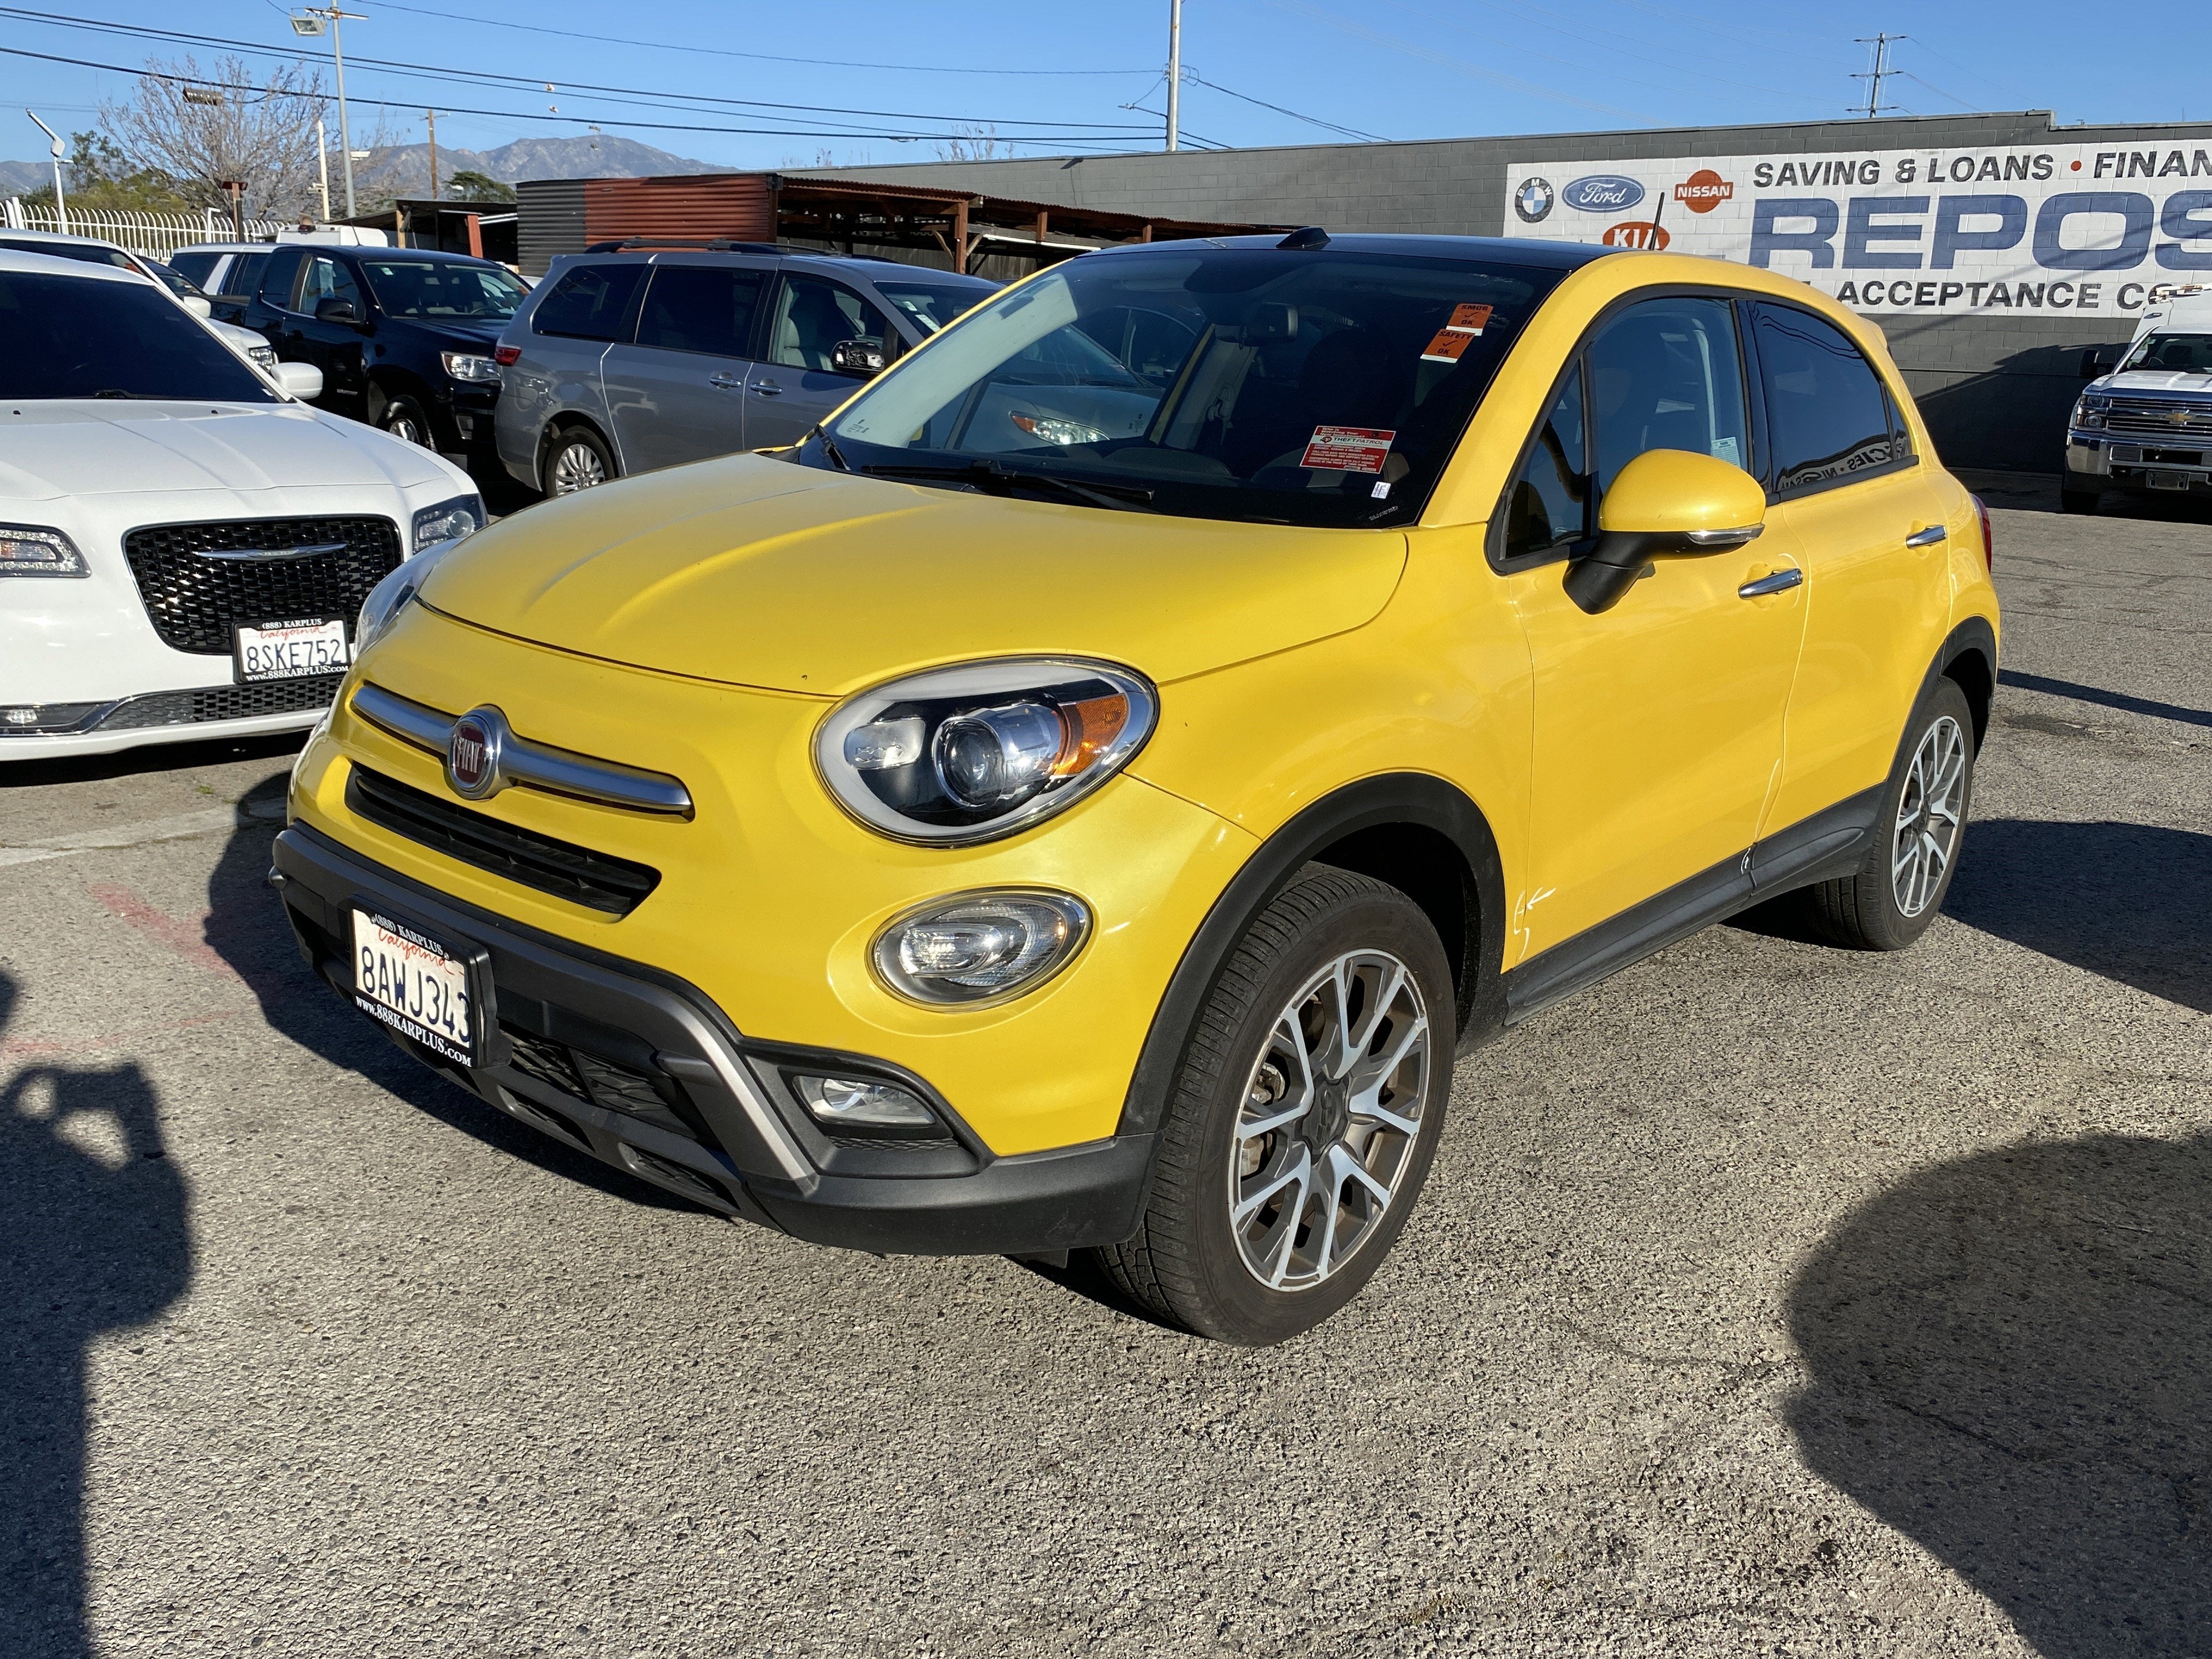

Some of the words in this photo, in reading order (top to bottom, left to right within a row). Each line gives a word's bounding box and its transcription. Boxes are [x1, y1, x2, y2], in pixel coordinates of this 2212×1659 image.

[1753, 160, 1880, 187] SAVING
[1895, 159, 1916, 183] &
[1928, 154, 2053, 182] LOANS
[2094, 149, 2212, 178] FINAN
[1517, 179, 1552, 198] BMW
[1579, 183, 1627, 204] Ford
[1677, 185, 1730, 198] NISSAN
[1613, 228, 1660, 250] KIA
[1837, 280, 2101, 308] ACCEPTANCE
[1438, 331, 1472, 339] SAFETY
[260, 626, 327, 640] California
[262, 622, 282, 630] (888)
[284, 618, 322, 628] KARPLUS
[247, 639, 341, 672] 8SKE752
[375, 913, 396, 933] (888)
[397, 924, 443, 956] KARPLUS
[379, 928, 454, 975] California
